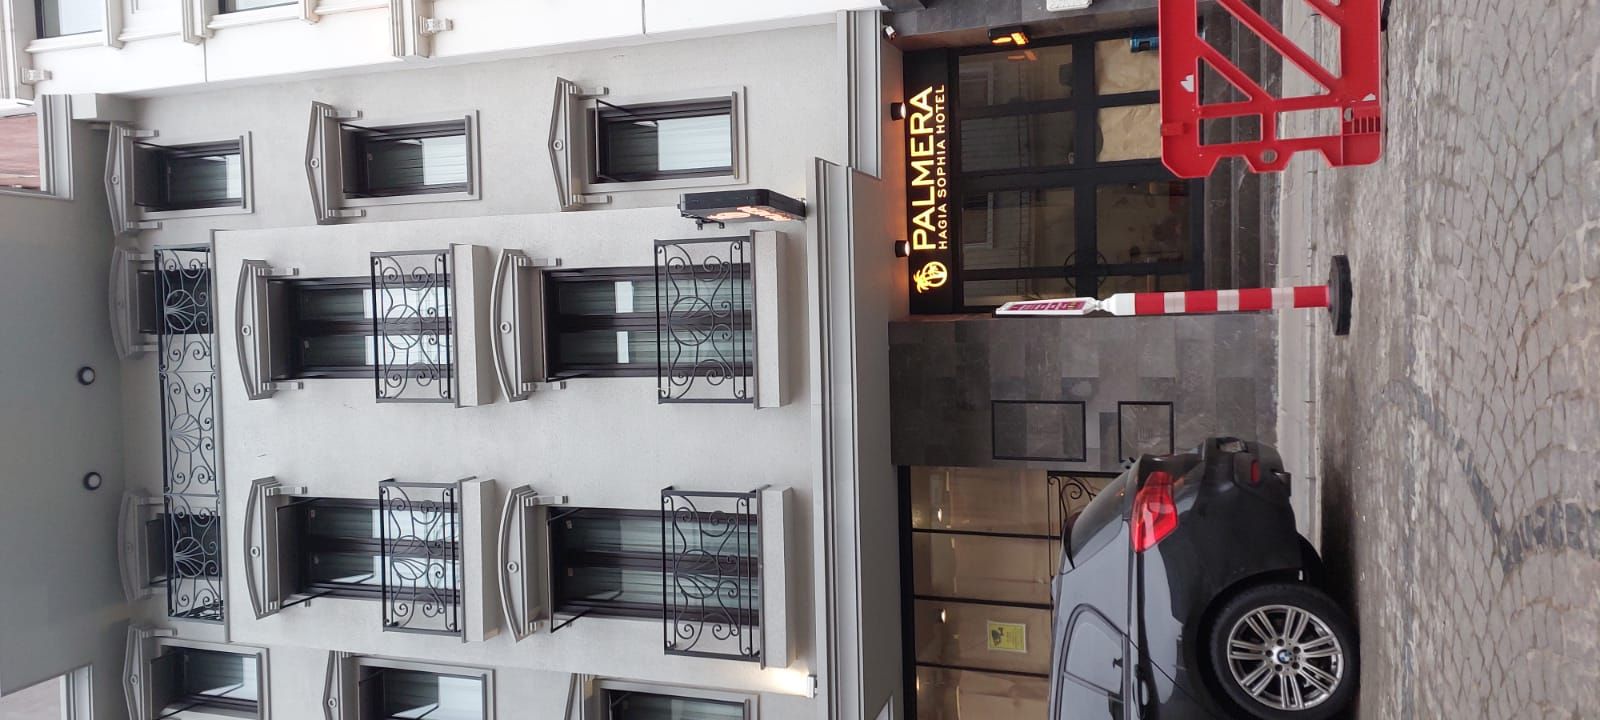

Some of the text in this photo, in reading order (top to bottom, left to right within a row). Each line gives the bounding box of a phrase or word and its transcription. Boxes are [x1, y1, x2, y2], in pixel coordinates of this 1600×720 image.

[910, 86, 937, 251] PALMERA
[935, 84, 948, 250] HAGIA SOPHIA HOTEL
